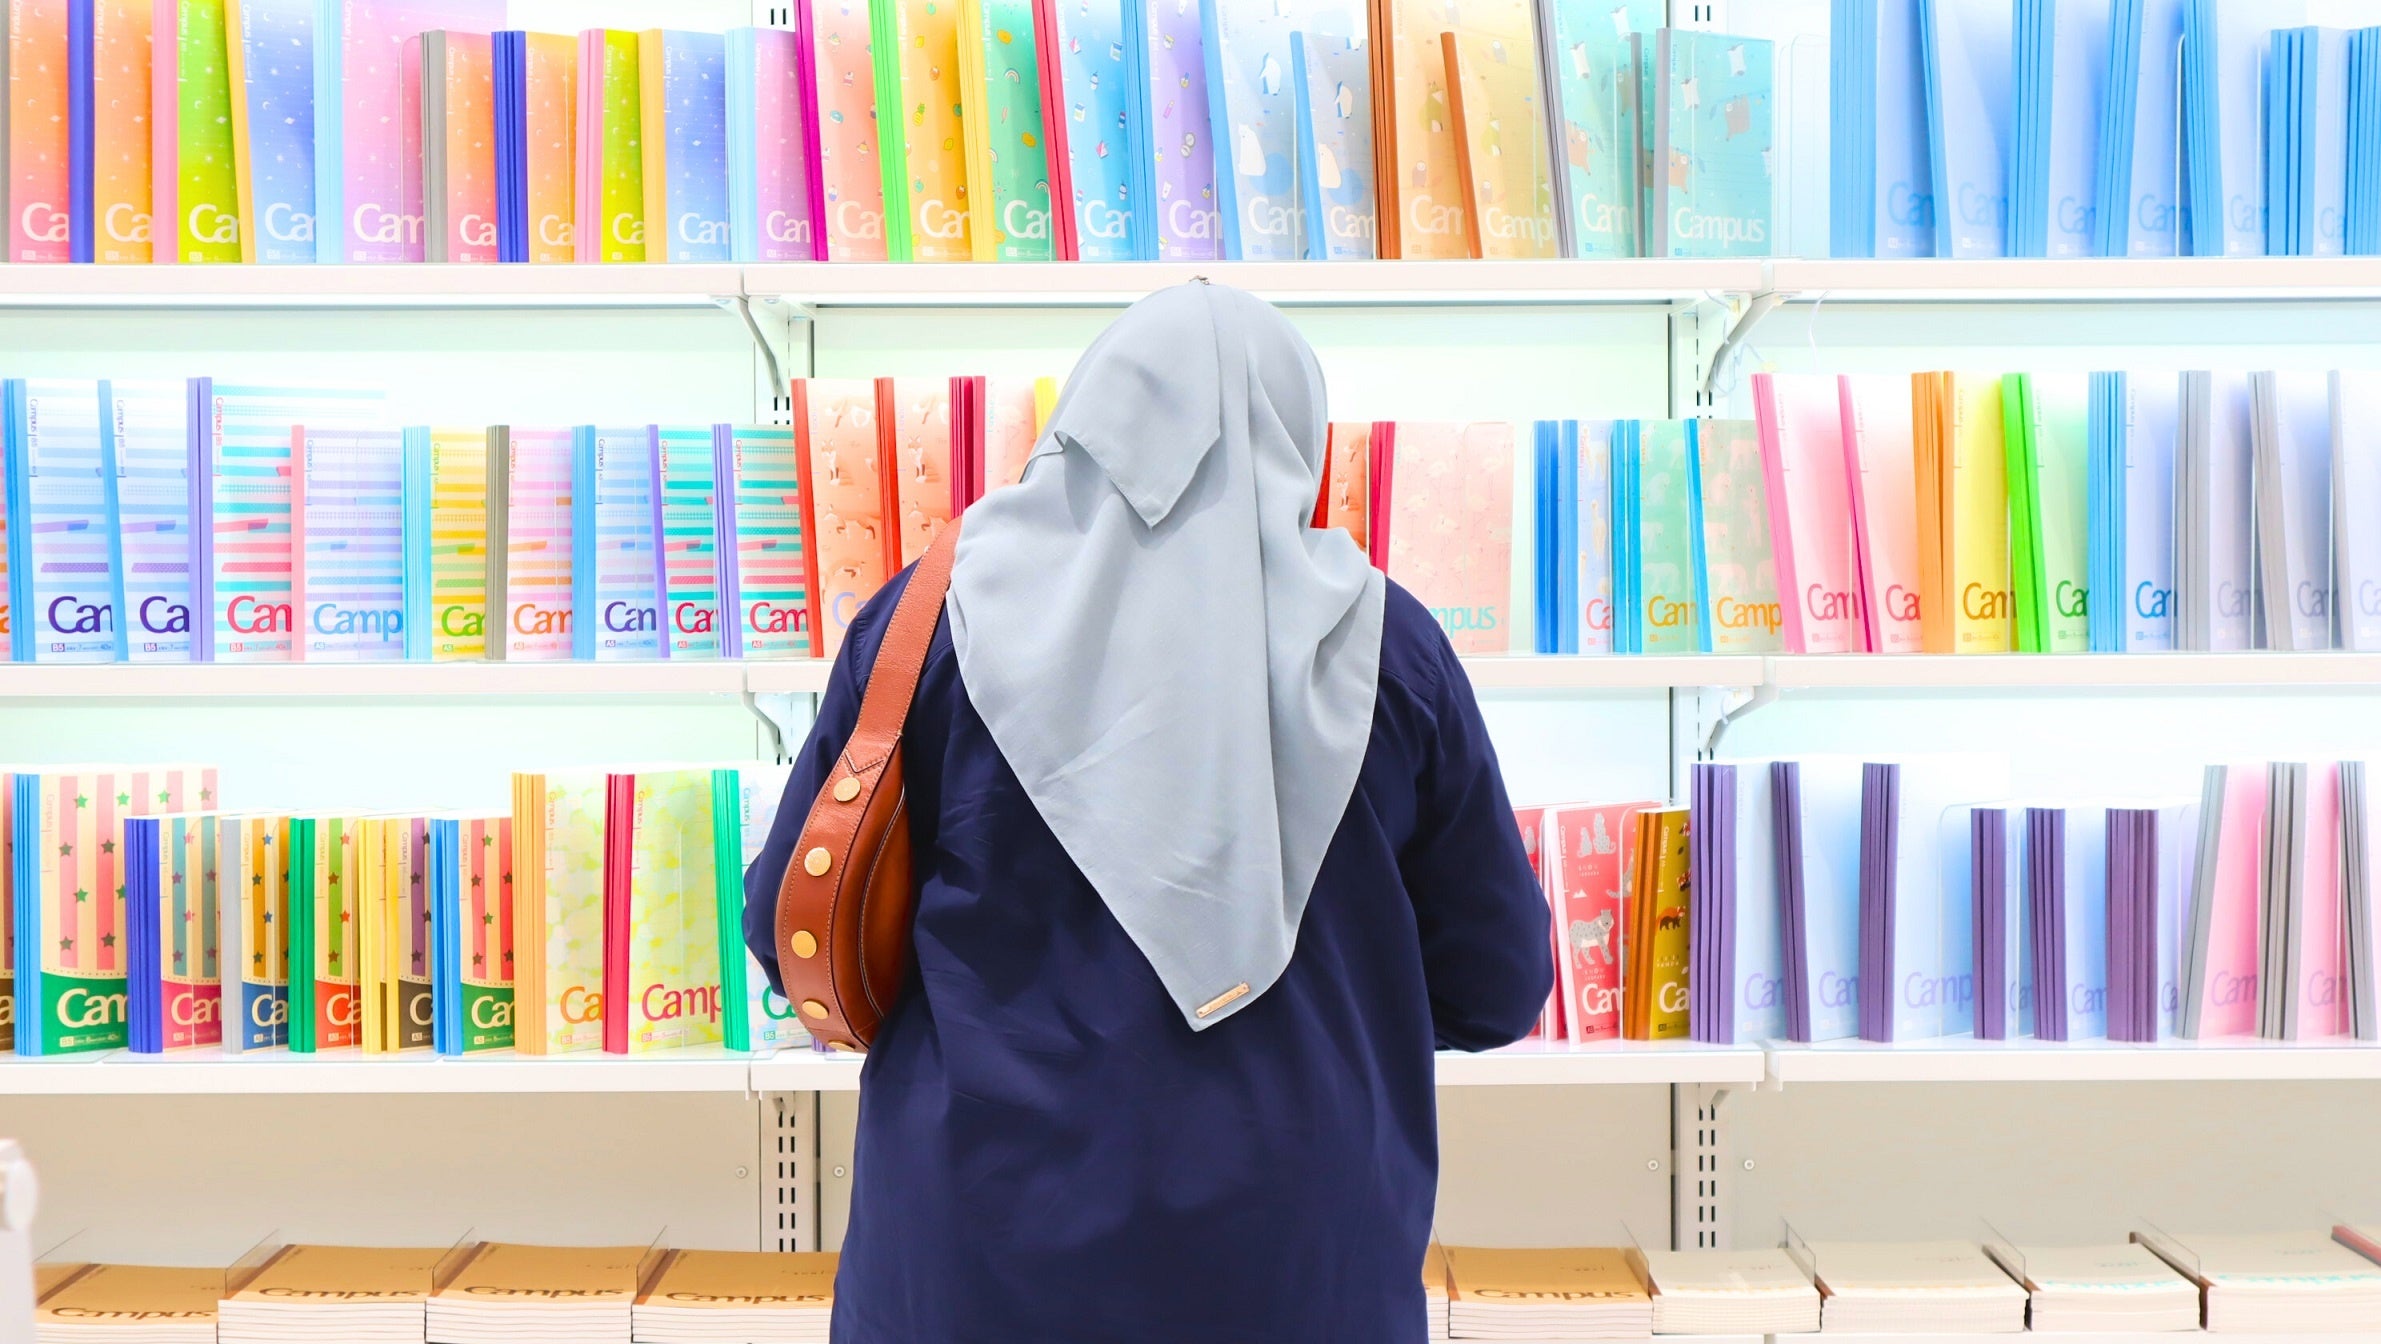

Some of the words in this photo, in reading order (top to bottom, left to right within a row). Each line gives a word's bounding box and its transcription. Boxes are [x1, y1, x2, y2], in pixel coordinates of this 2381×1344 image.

[188, 203, 239, 244] Ca
[1674, 207, 1765, 249] Campus
[215, 396, 224, 431] Campus
[140, 596, 190, 634] Ca
[441, 605, 485, 638] Ca
[1717, 597, 1782, 636] Camp
[410, 993, 432, 1026] C
[764, 1030, 775, 1041] B5
[258, 1287, 421, 1300] Campus
[463, 1285, 625, 1299] Campus
[666, 1291, 825, 1305] Campus
[1474, 1288, 1635, 1301] Campus
[51, 1306, 218, 1321] Campus
